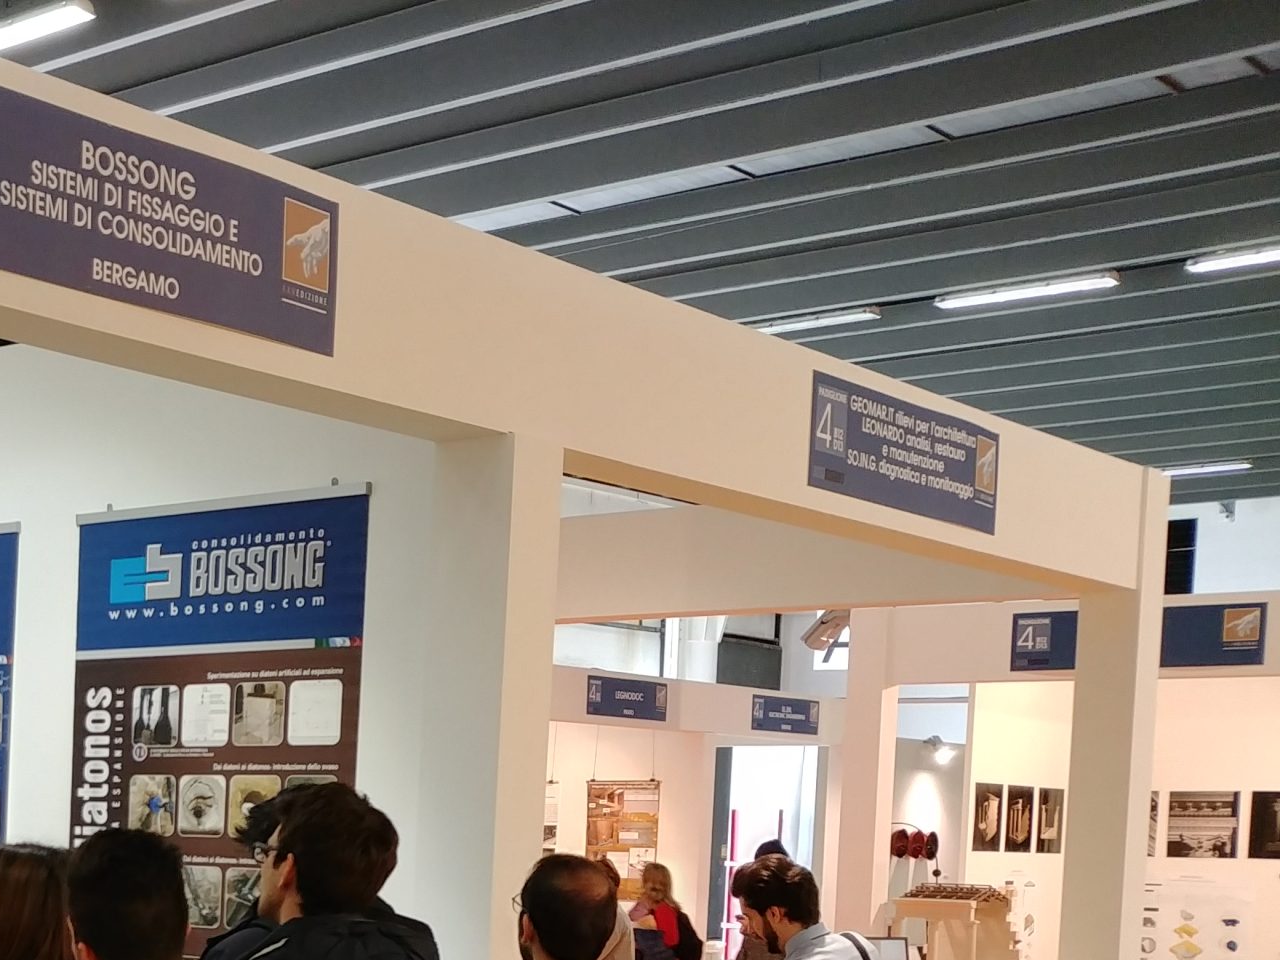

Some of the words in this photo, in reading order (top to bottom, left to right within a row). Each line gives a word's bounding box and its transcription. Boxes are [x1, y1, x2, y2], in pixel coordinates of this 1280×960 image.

[81, 139, 197, 201] BOSSONG
[31, 159, 99, 202] SISTEMI
[103, 182, 123, 210] DI
[127, 189, 225, 238] FISSAGGIO
[229, 219, 239, 243] E
[0, 179, 69, 223] SISTEMI
[73, 202, 92, 230] DI
[97, 210, 263, 277] CONSOLIDAMENTO
[92, 257, 180, 300] BERGAMO
[816, 402, 832, 449] 4
[850, 394, 895, 423] GEOMAR.IT
[915, 418, 930, 435] per
[861, 416, 905, 444] LEONARDO
[934, 442, 966, 462] restauro
[882, 444, 889, 457] e
[889, 446, 945, 473] manutenzione
[878, 458, 920, 484] diagnostica
[920, 473, 927, 486] e
[927, 475, 975, 500] monitoraggio
[191, 527, 325, 550] consolidamento
[189, 540, 326, 598] BOSSONG
[108, 595, 325, 621] www.bossong.com
[1016, 625, 1035, 650] 4
[111, 687, 125, 808] ESPANSIONE
